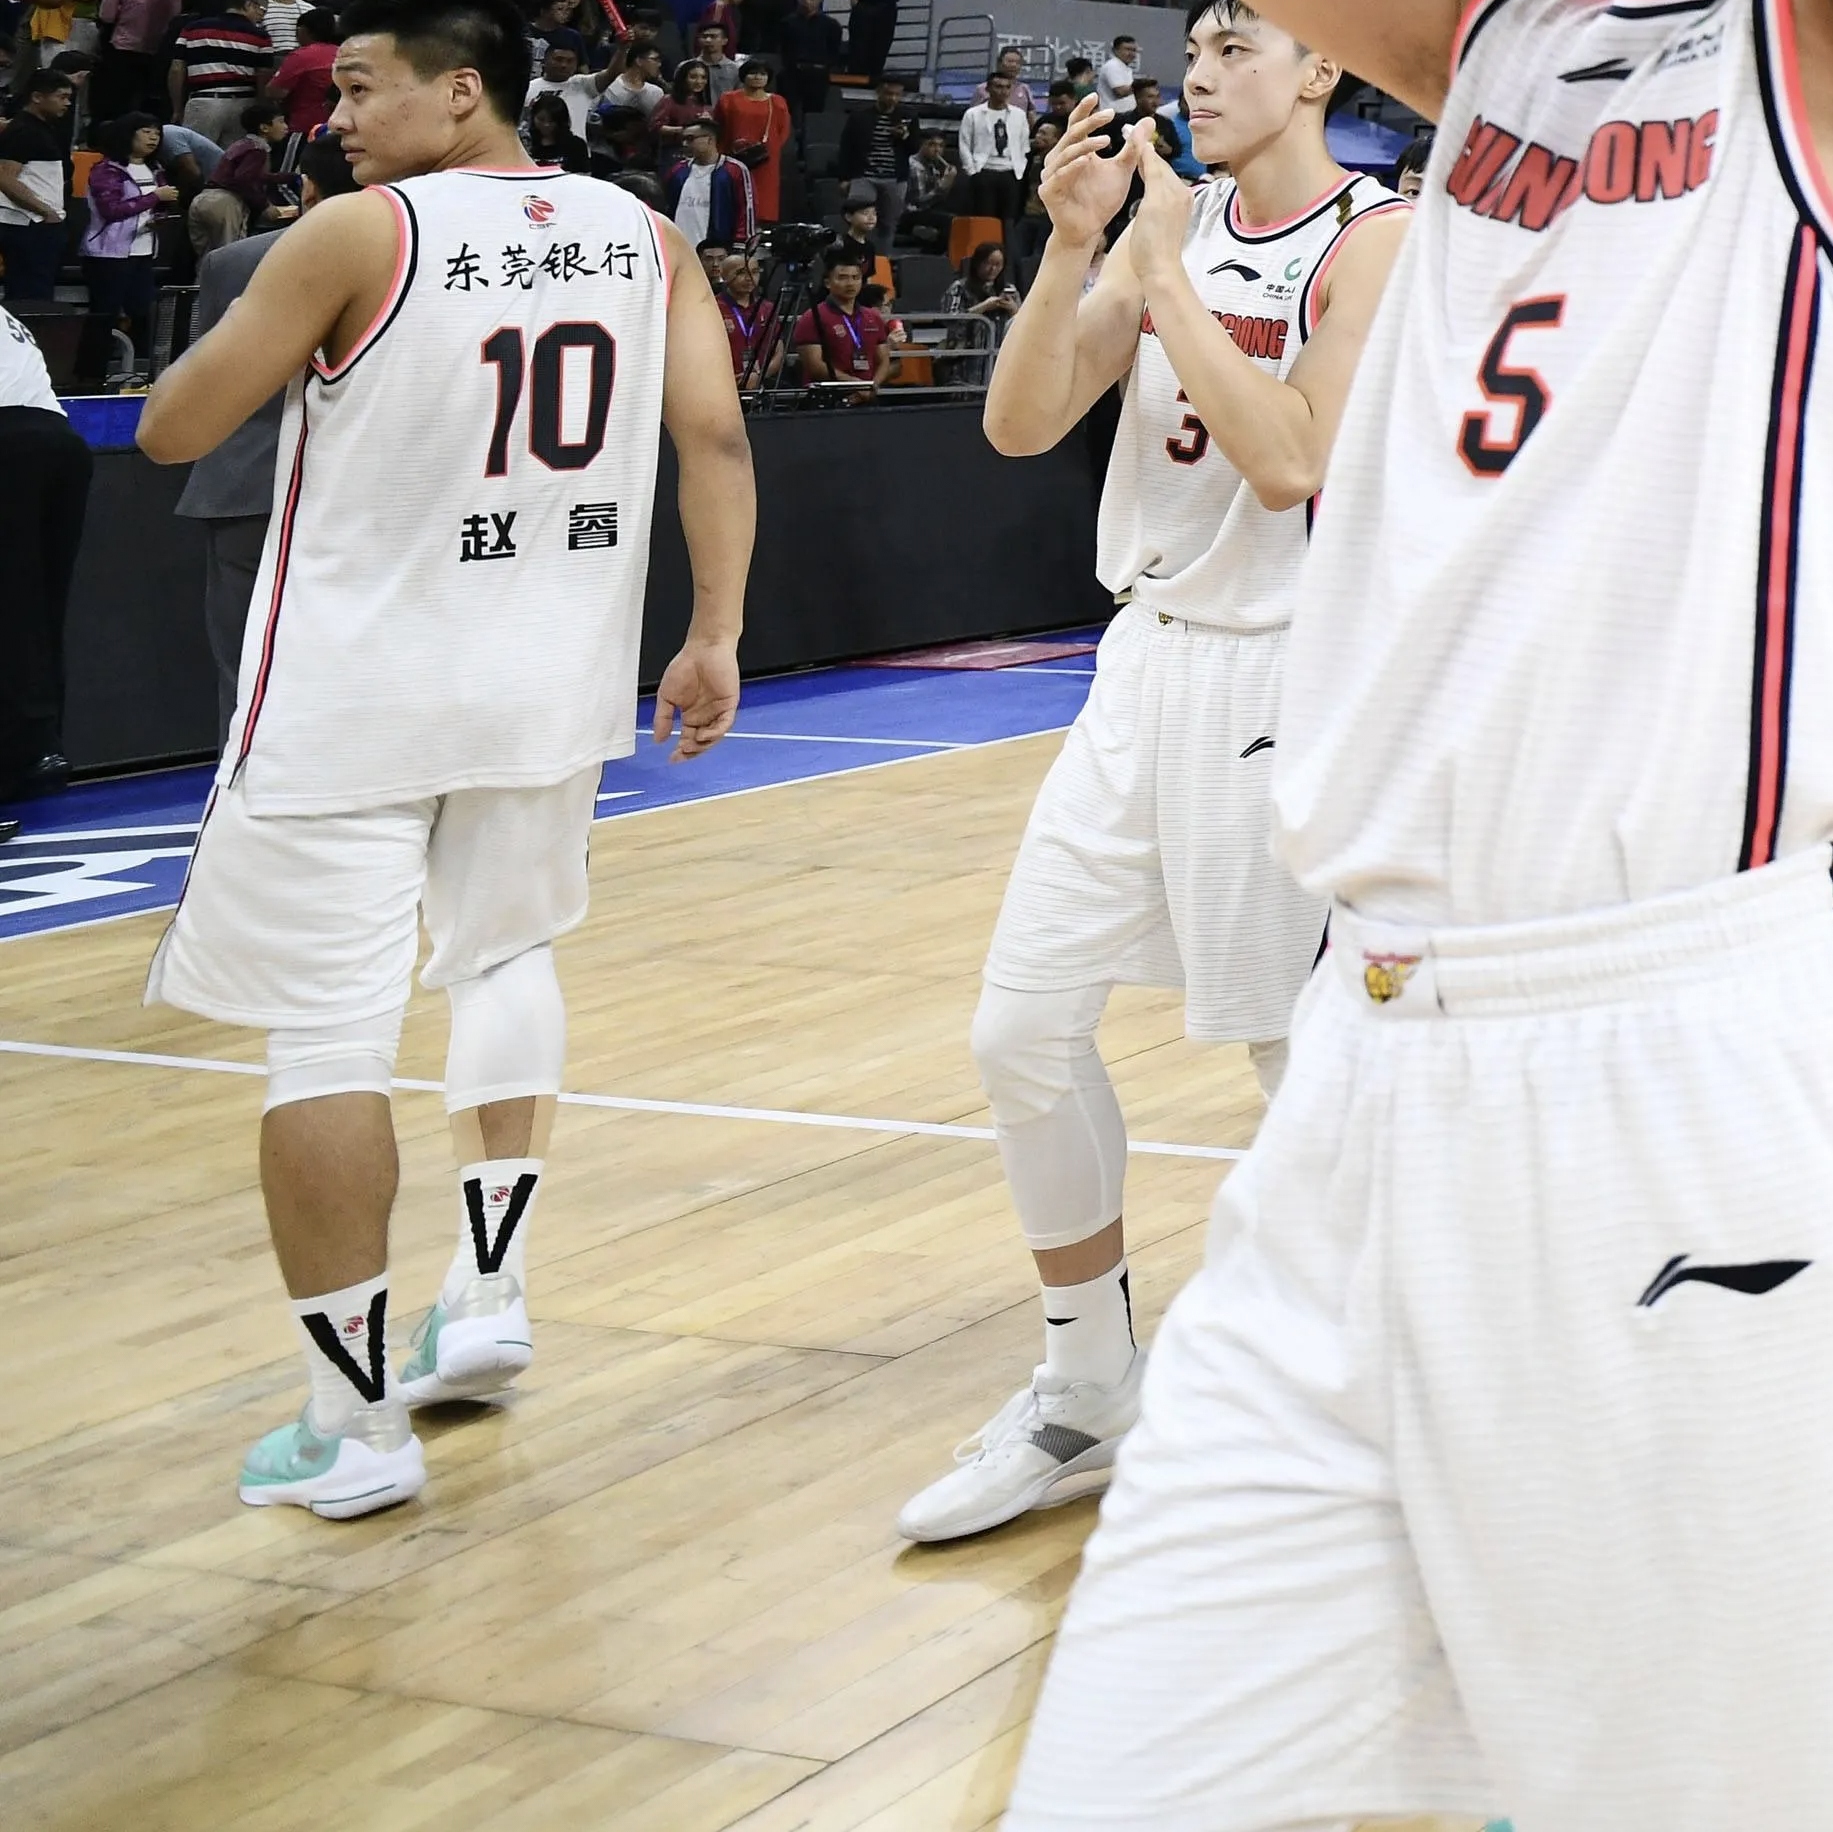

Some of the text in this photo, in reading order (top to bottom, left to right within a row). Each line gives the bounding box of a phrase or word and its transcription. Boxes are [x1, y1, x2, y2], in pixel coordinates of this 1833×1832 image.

[443, 242, 640, 293] 东莞银行
[480, 320, 617, 479] 10
[1457, 293, 1567, 479] 5
